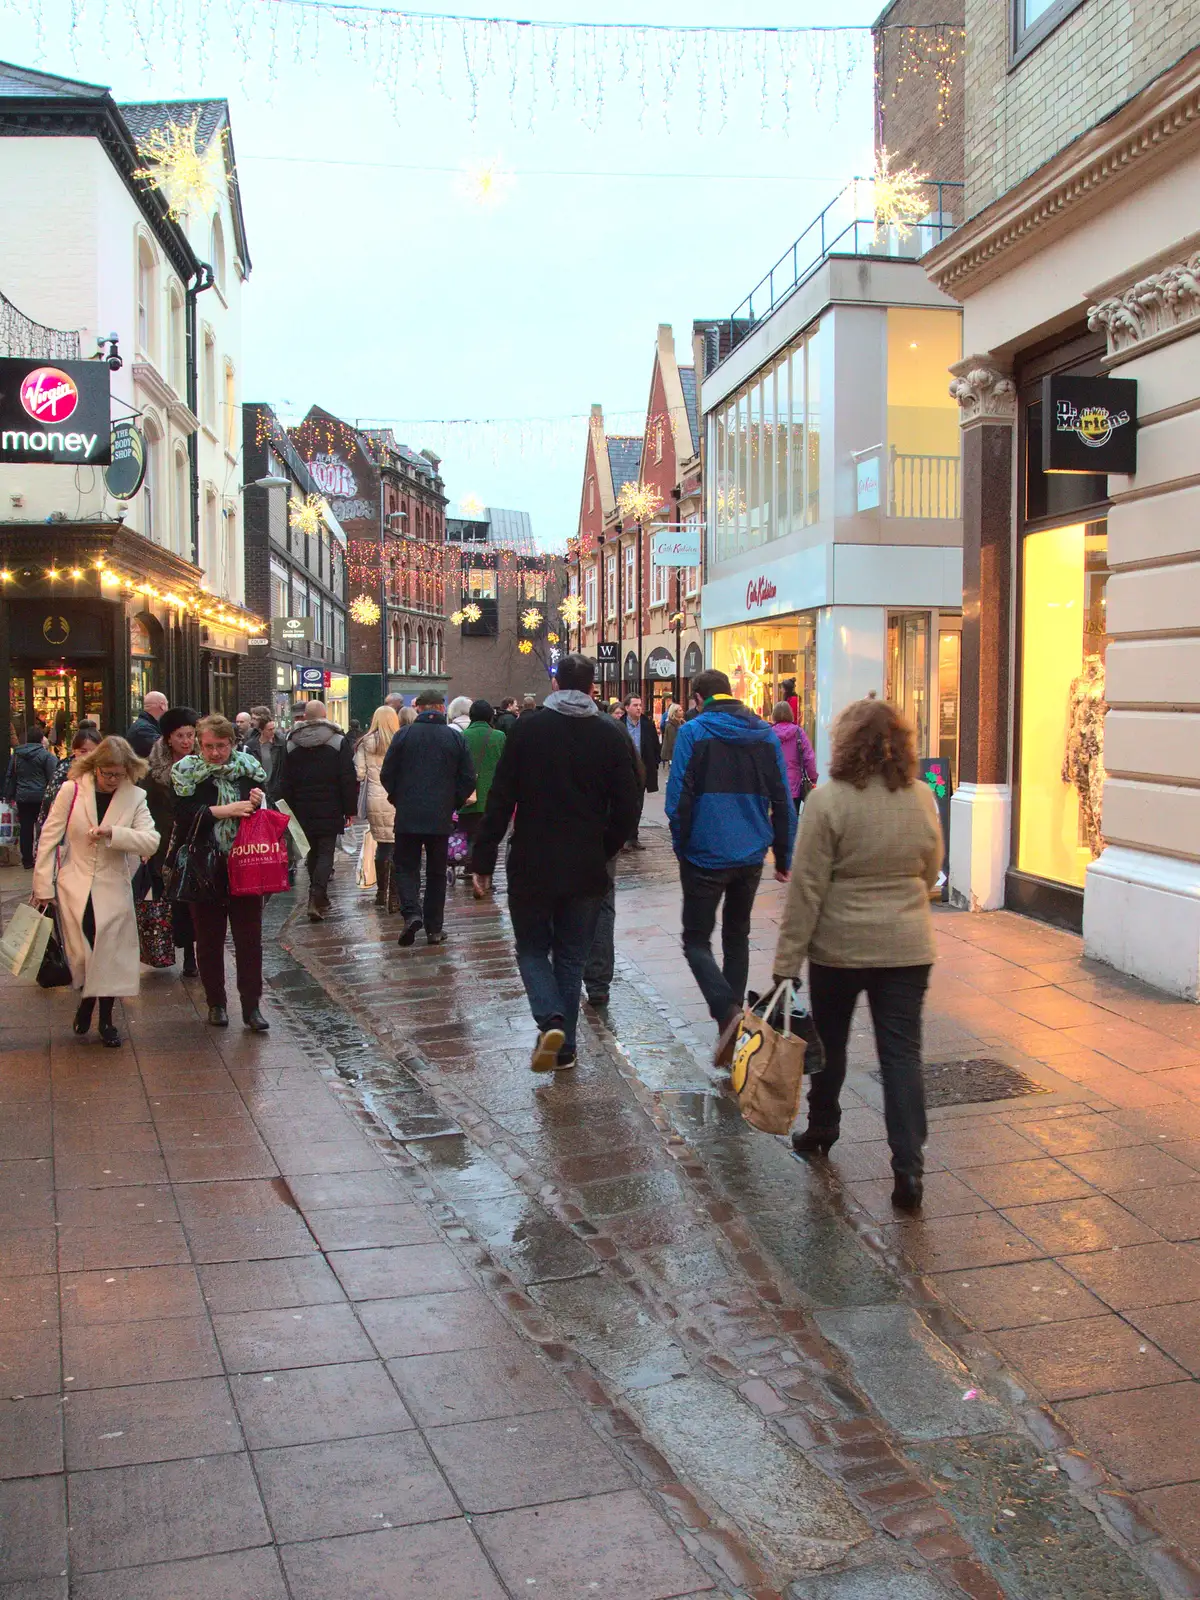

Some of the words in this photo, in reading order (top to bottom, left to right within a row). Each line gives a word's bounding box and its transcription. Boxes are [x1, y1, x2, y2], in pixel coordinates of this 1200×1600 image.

[25, 373, 75, 416] Virgin
[1057, 410, 1130, 431] Martens
[116, 429, 128, 438] THE
[2, 431, 98, 458] money
[115, 438, 131, 449] BODY
[115, 448, 131, 460] SHOP
[600, 645, 614, 656] W
[232, 843, 270, 857] FOUND
